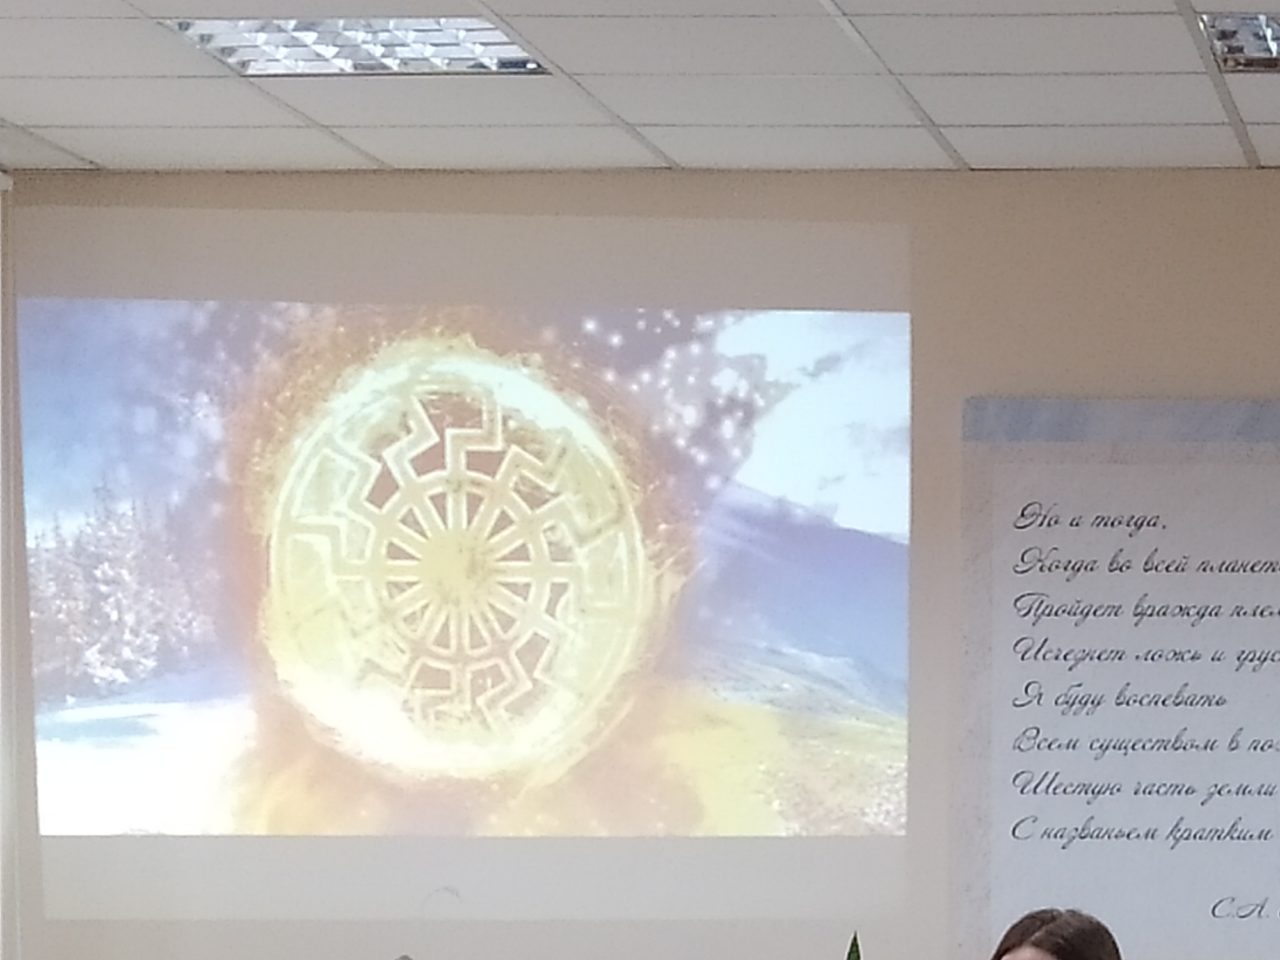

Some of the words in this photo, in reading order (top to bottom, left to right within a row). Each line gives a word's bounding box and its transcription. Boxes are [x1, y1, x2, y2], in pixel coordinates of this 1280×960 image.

[1012, 500, 1062, 530] Но
[1068, 514, 1084, 528] и
[1011, 545, 1100, 583] Когда
[1107, 547, 1134, 574] во
[1142, 546, 1191, 574] всей
[1012, 591, 1125, 628] Пройдет
[1132, 592, 1224, 628] вражда
[1012, 636, 1128, 673] Исчезнет
[1134, 648, 1203, 663] ложь
[1210, 649, 1227, 663] и
[1011, 680, 1044, 709] Я
[1053, 682, 1107, 717] буду
[1114, 681, 1228, 708] воспевать
[1011, 725, 1081, 753] Всем
[1088, 726, 1220, 762] существом
[1226, 726, 1245, 753] в
[1011, 769, 1123, 806] Шестую
[1132, 780, 1198, 797] часть
[1201, 782, 1278, 807] земли
[1011, 814, 1039, 841] С
[1039, 814, 1159, 851] названьем
[1164, 815, 1275, 851] кратким
